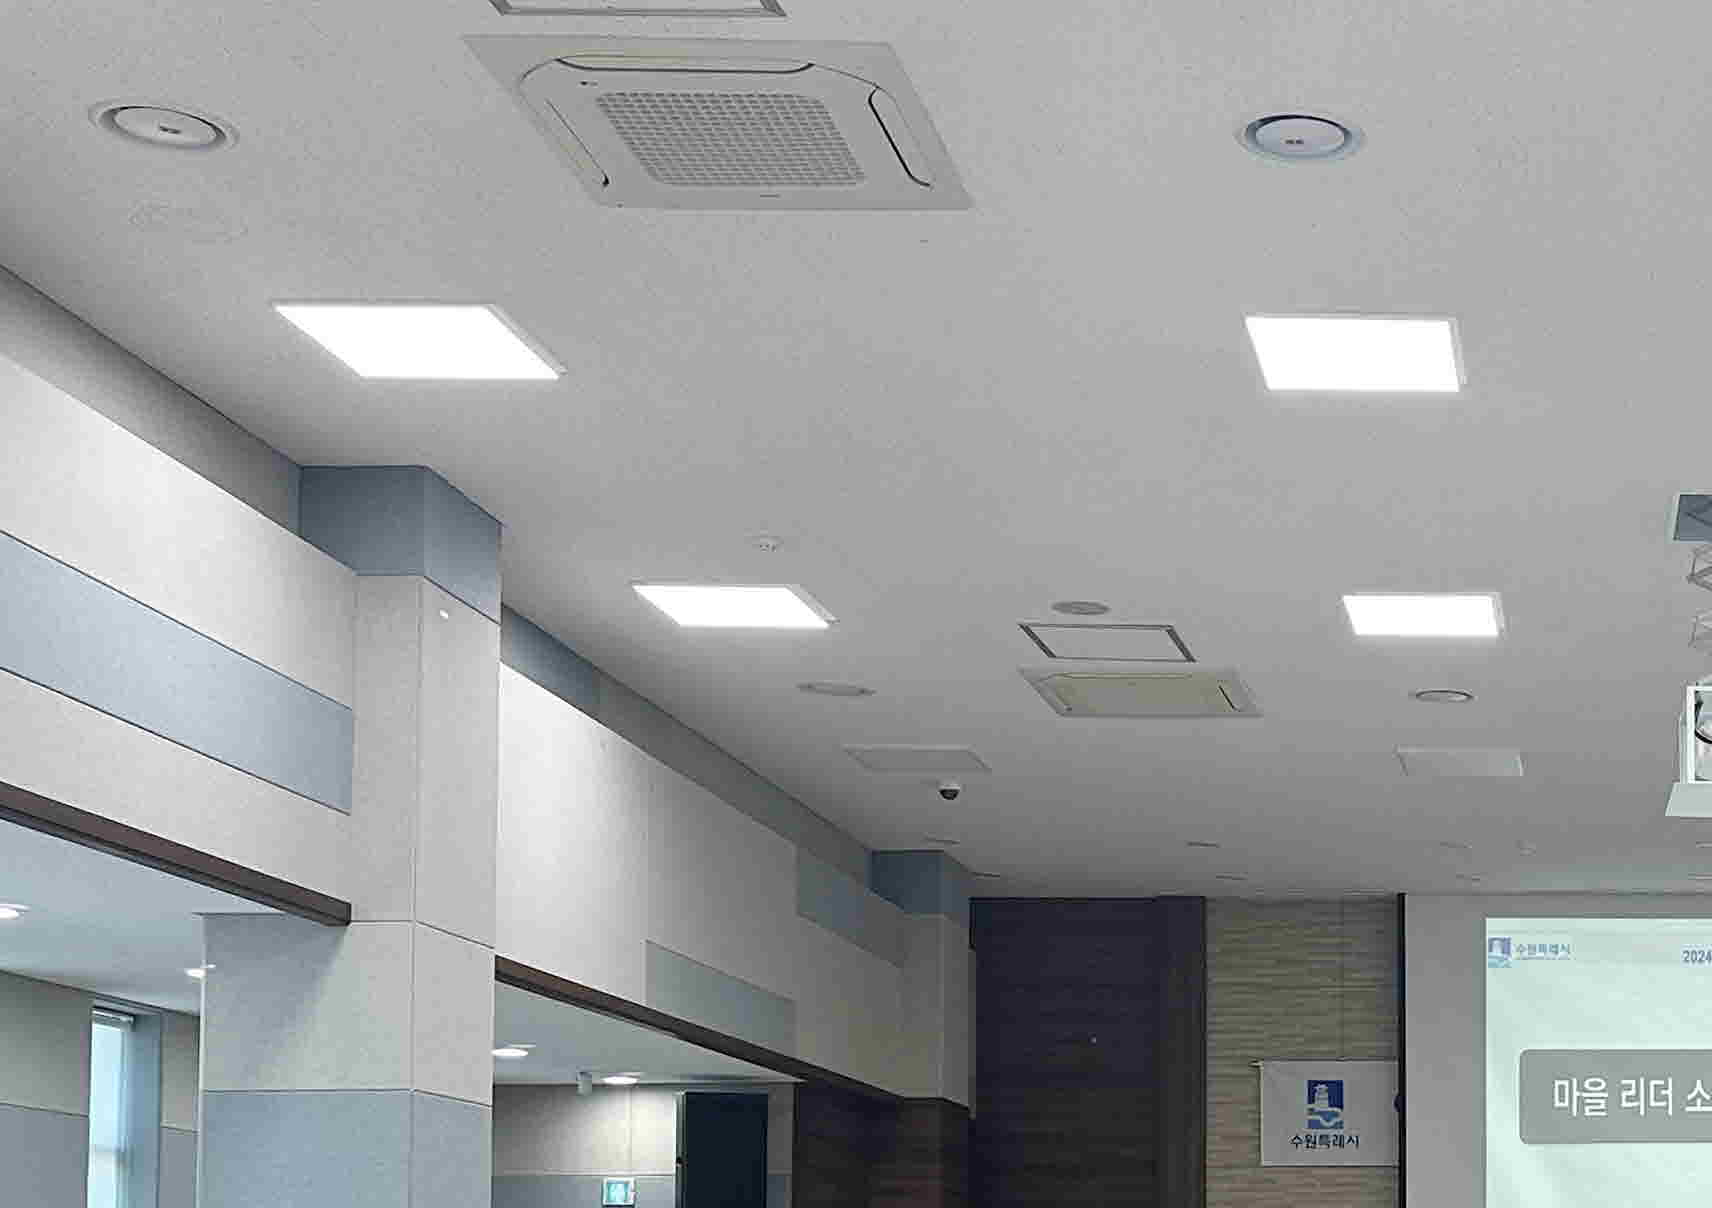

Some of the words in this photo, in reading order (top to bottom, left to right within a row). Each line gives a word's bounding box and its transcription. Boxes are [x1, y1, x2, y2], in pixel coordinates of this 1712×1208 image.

[1553, 1077, 1609, 1116] 마을
[1620, 1077, 1673, 1116] 리더
[1289, 1135, 1360, 1149] 수원특례시
